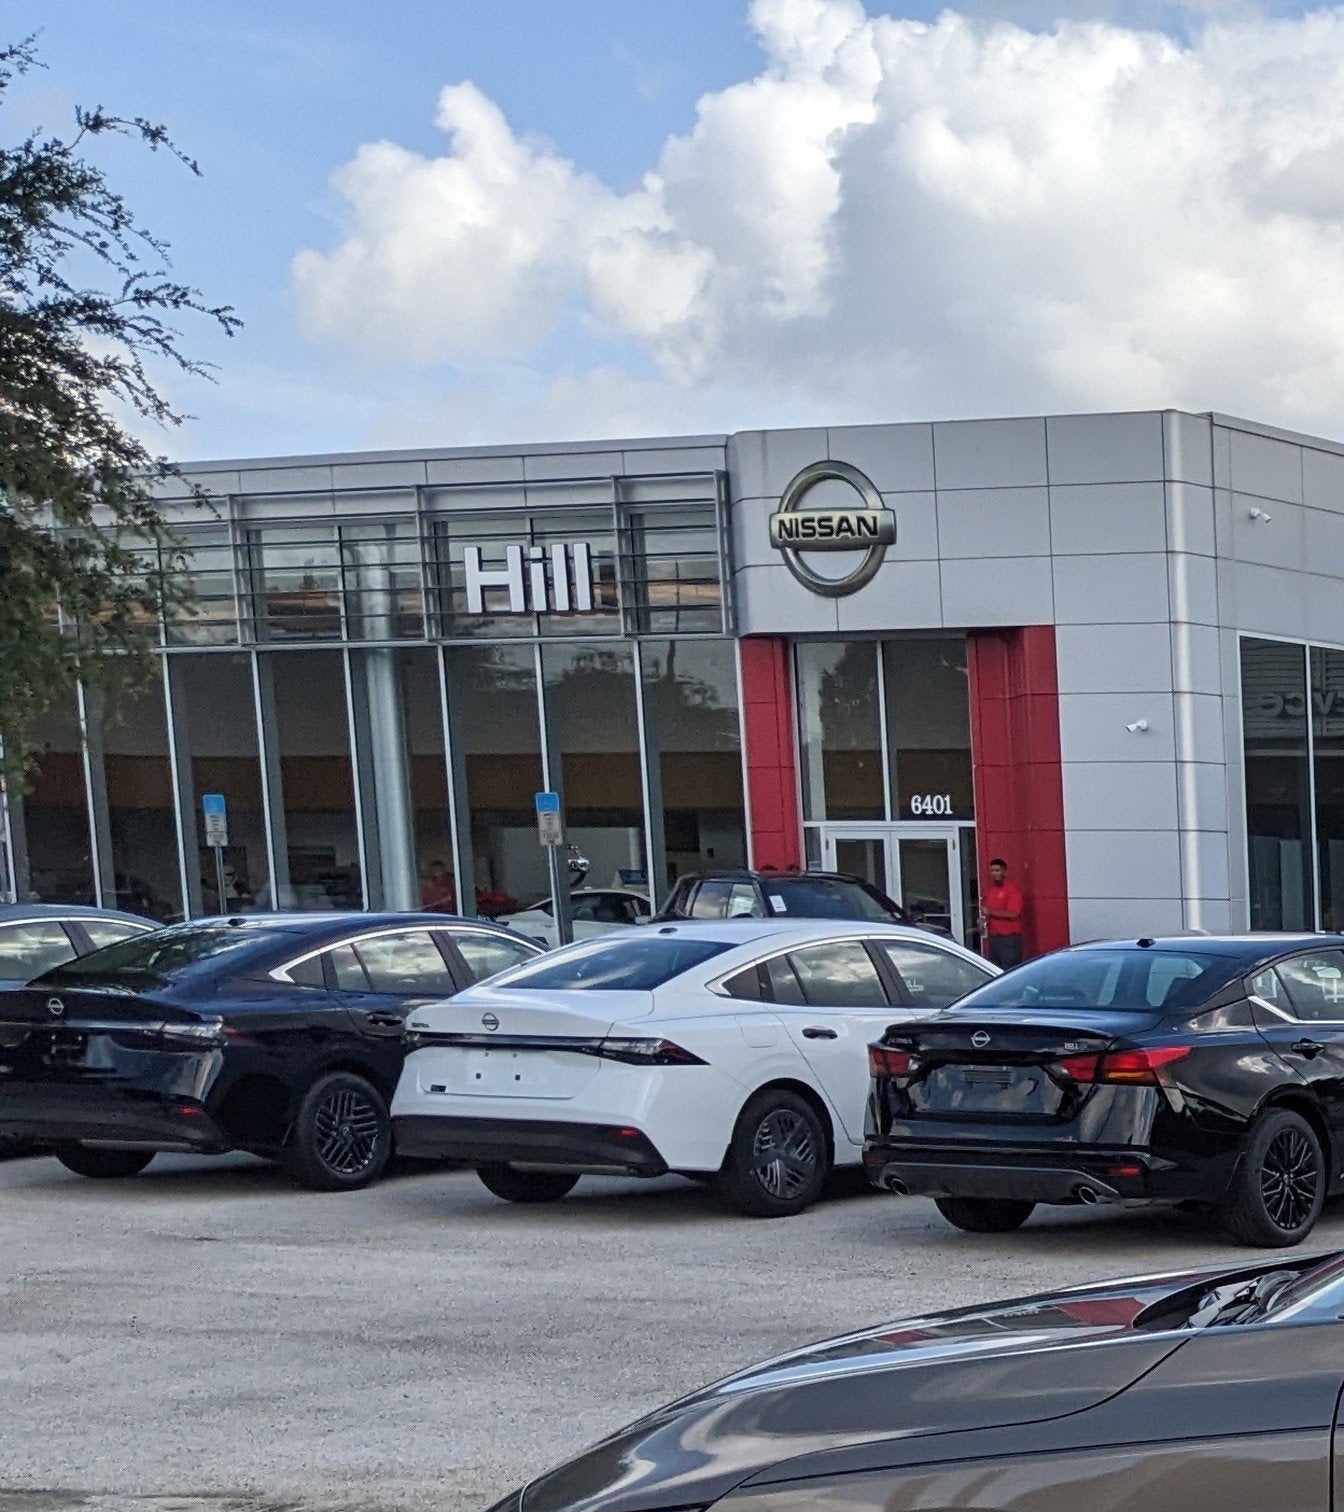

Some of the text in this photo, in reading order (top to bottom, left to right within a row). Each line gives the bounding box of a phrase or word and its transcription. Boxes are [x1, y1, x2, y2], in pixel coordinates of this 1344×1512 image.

[778, 515, 878, 539] NISSAN
[464, 543, 592, 614] Hill
[911, 795, 953, 815] 6401
